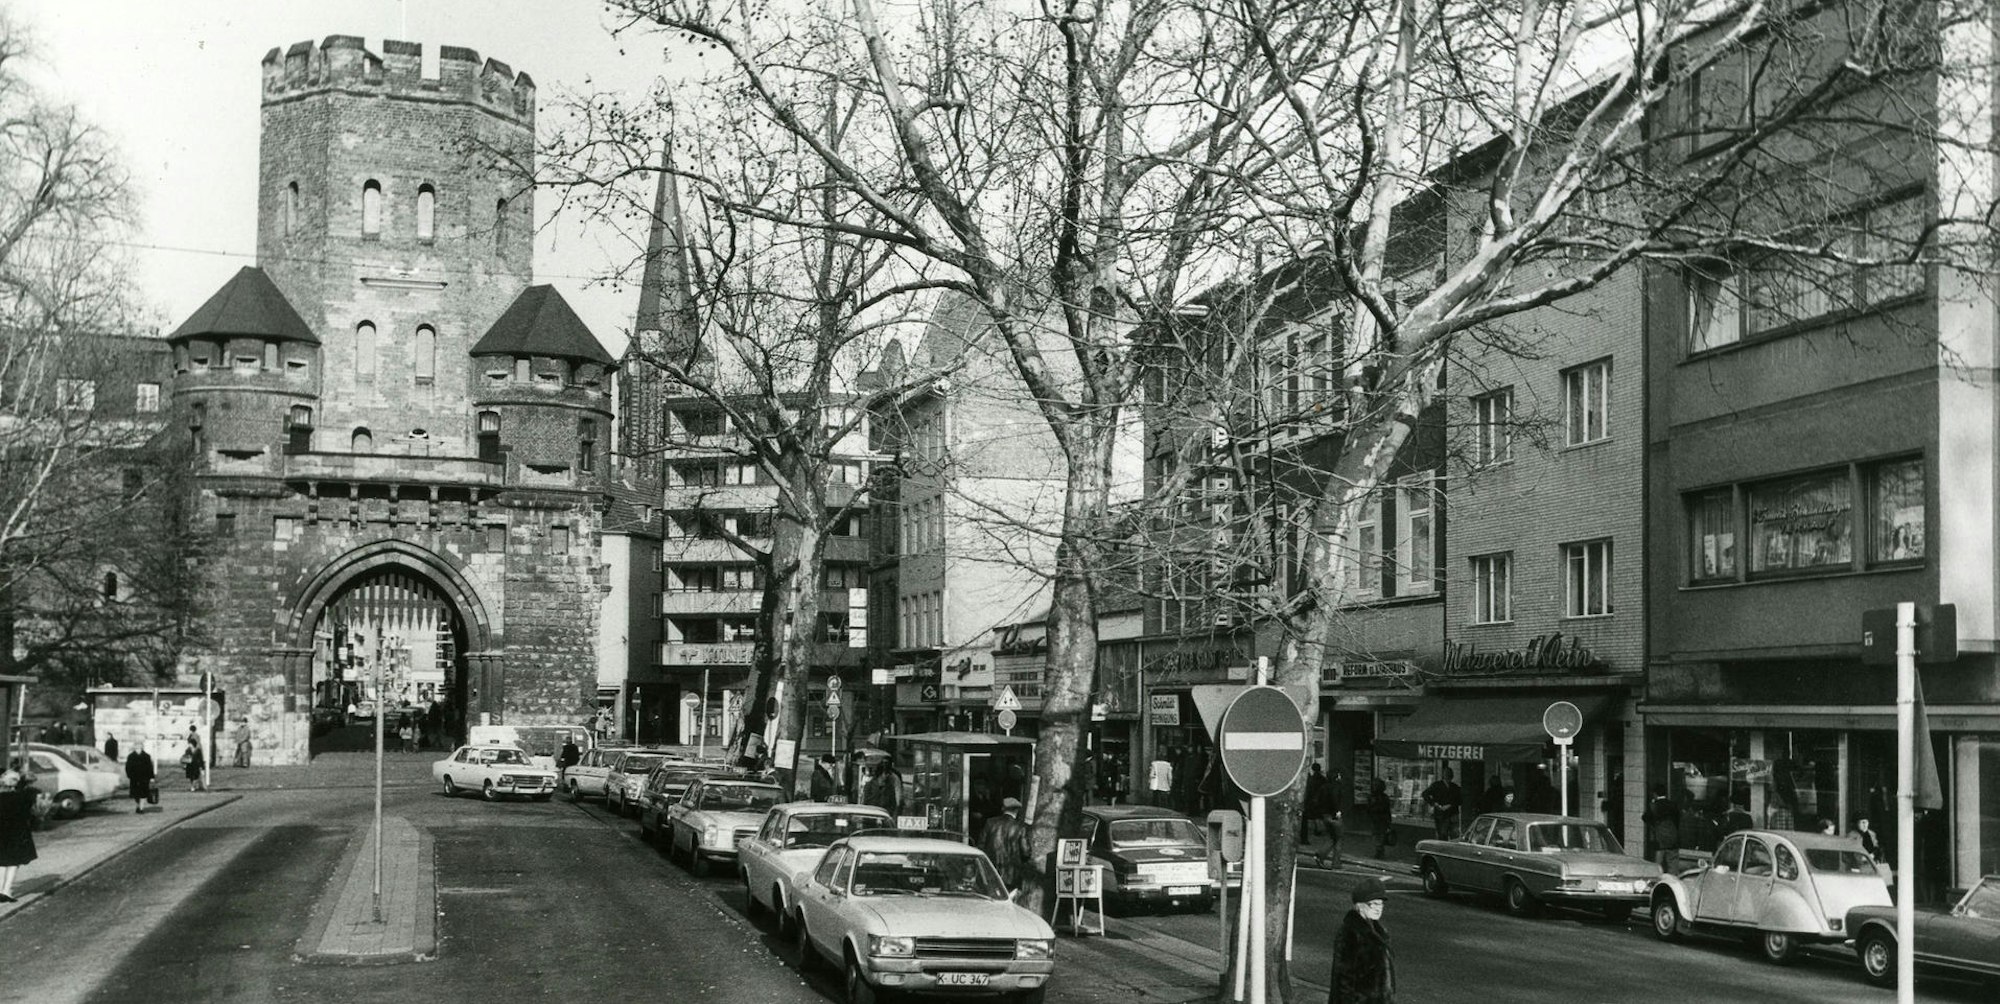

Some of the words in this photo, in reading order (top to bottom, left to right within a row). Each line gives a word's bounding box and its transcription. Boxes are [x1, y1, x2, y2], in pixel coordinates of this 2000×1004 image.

[1444, 637, 1533, 671] Metzgerei
[1536, 632, 1594, 669] Klein
[1418, 745, 1484, 760] METZGEREI
[900, 818, 925, 830] TAXI
[951, 974, 967, 984] UC
[970, 974, 988, 984] 347
